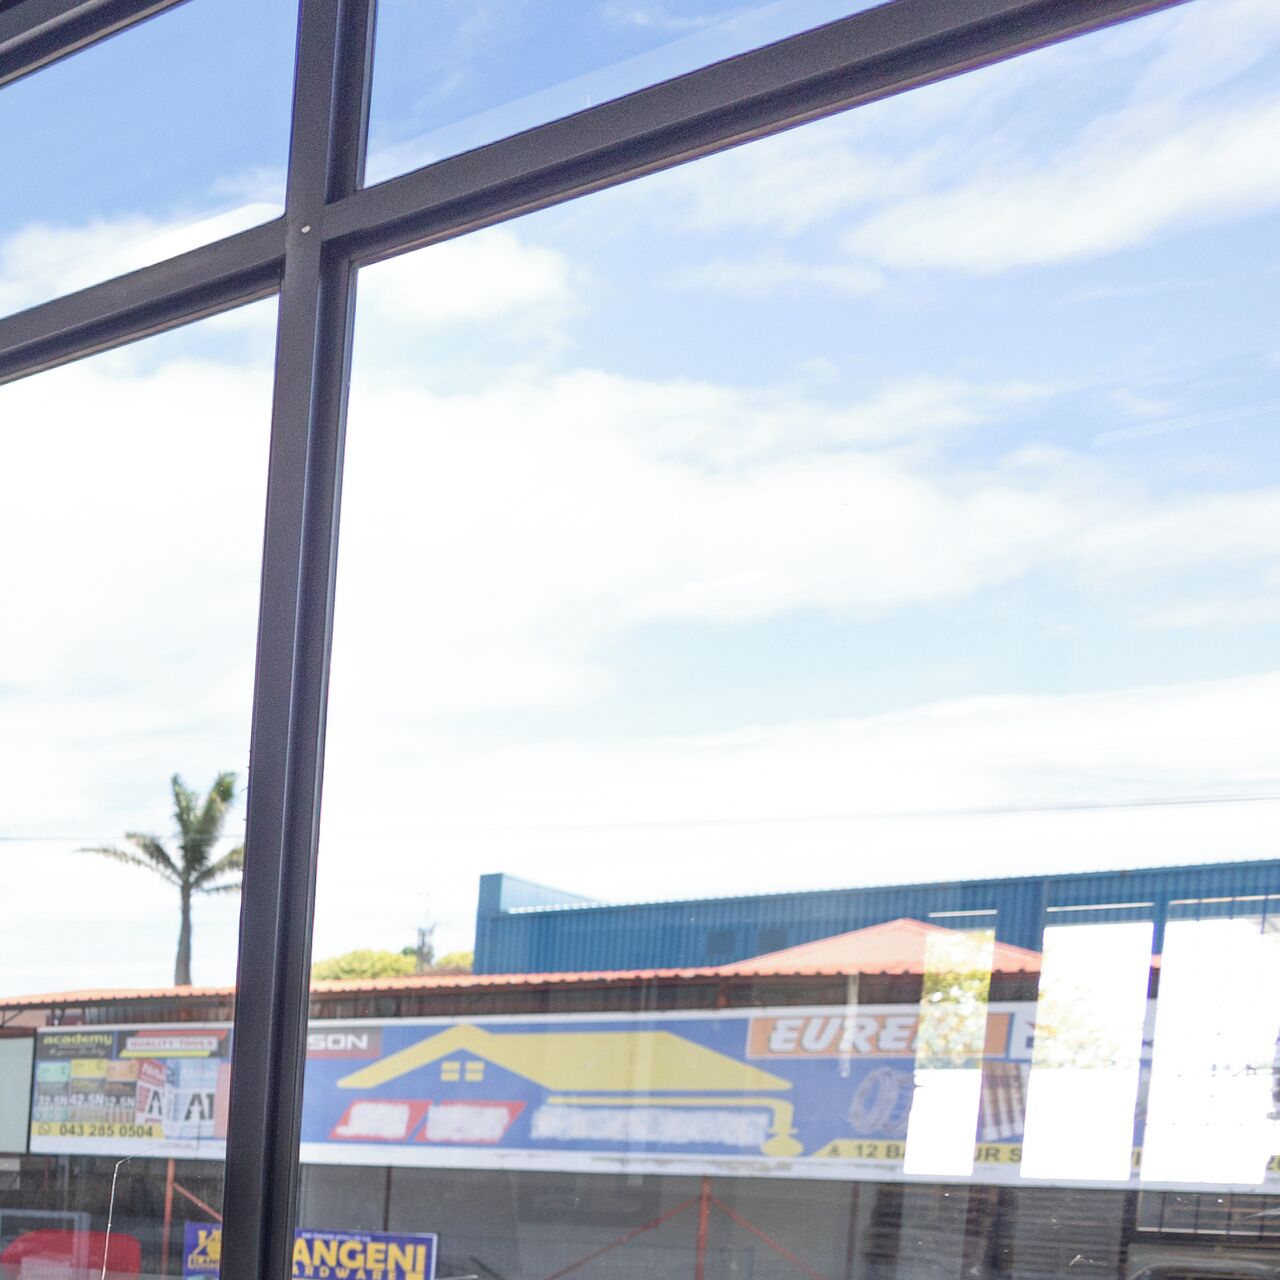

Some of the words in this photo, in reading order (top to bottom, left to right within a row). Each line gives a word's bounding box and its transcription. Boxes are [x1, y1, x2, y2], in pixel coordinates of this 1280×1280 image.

[43, 1033, 113, 1046] academy
[59, 1123, 84, 1136] 043
[89, 1124, 115, 1137] 285
[119, 1124, 154, 1138] 0504
[856, 1144, 878, 1158] 12
